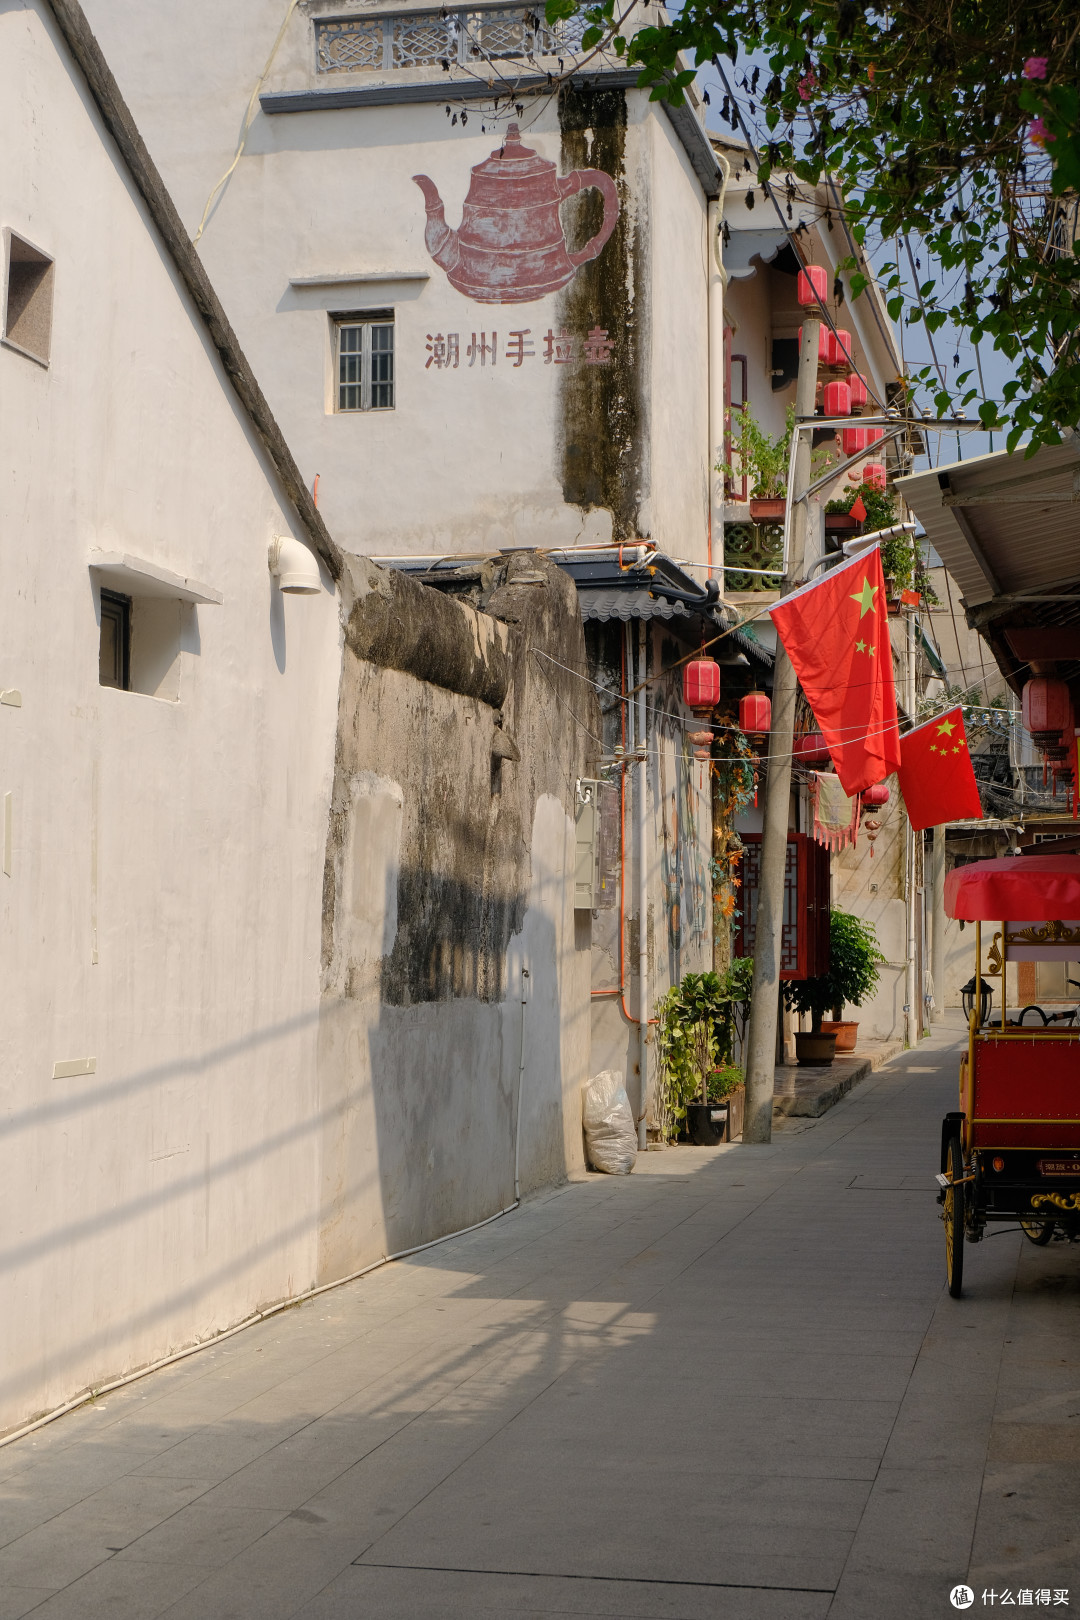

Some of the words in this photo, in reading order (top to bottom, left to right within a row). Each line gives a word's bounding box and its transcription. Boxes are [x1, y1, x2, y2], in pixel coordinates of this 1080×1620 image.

[425, 325, 615, 369] 潮州手拉壶
